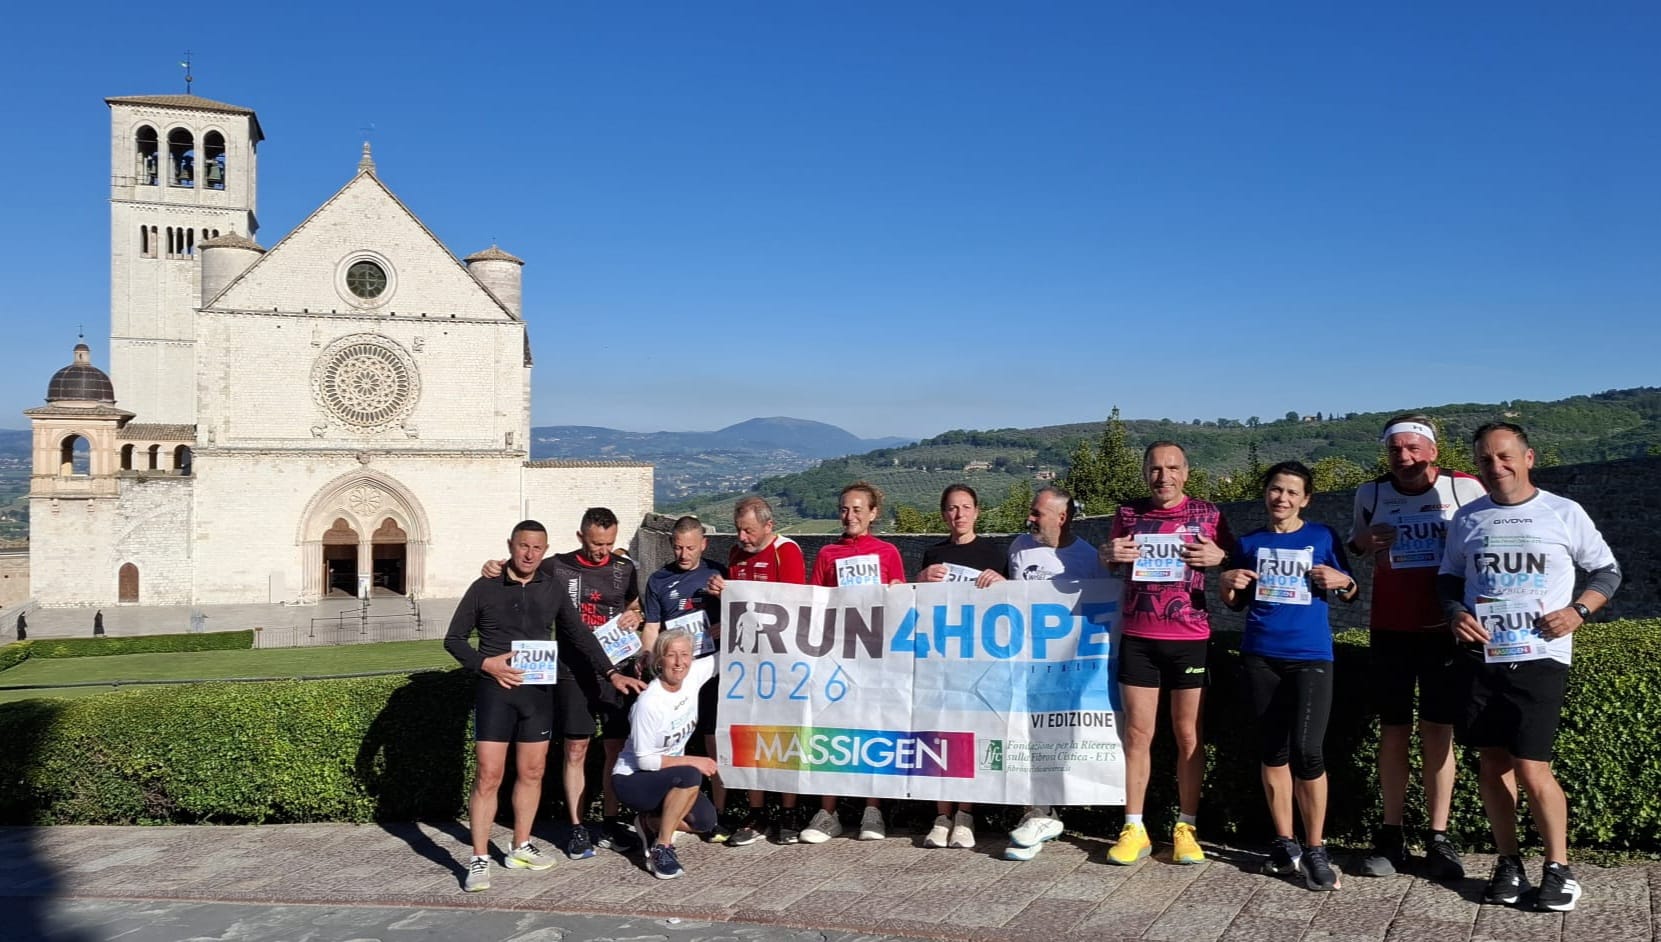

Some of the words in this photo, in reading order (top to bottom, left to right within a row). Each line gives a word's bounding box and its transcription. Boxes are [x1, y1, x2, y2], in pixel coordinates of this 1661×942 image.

[1137, 543, 1183, 558] RUN
[838, 564, 878, 577] RUN
[1260, 559, 1310, 577] RUN
[1474, 552, 1546, 575] RUN
[726, 661, 847, 701] 2026
[1031, 714, 1043, 728] VI
[1048, 712, 1113, 728] EDIZIONE
[754, 732, 948, 771] MASSIGEN
[1081, 740, 1117, 750] Ricerca
[1058, 751, 1088, 762] Cistica
[1096, 752, 1117, 761] ETS
